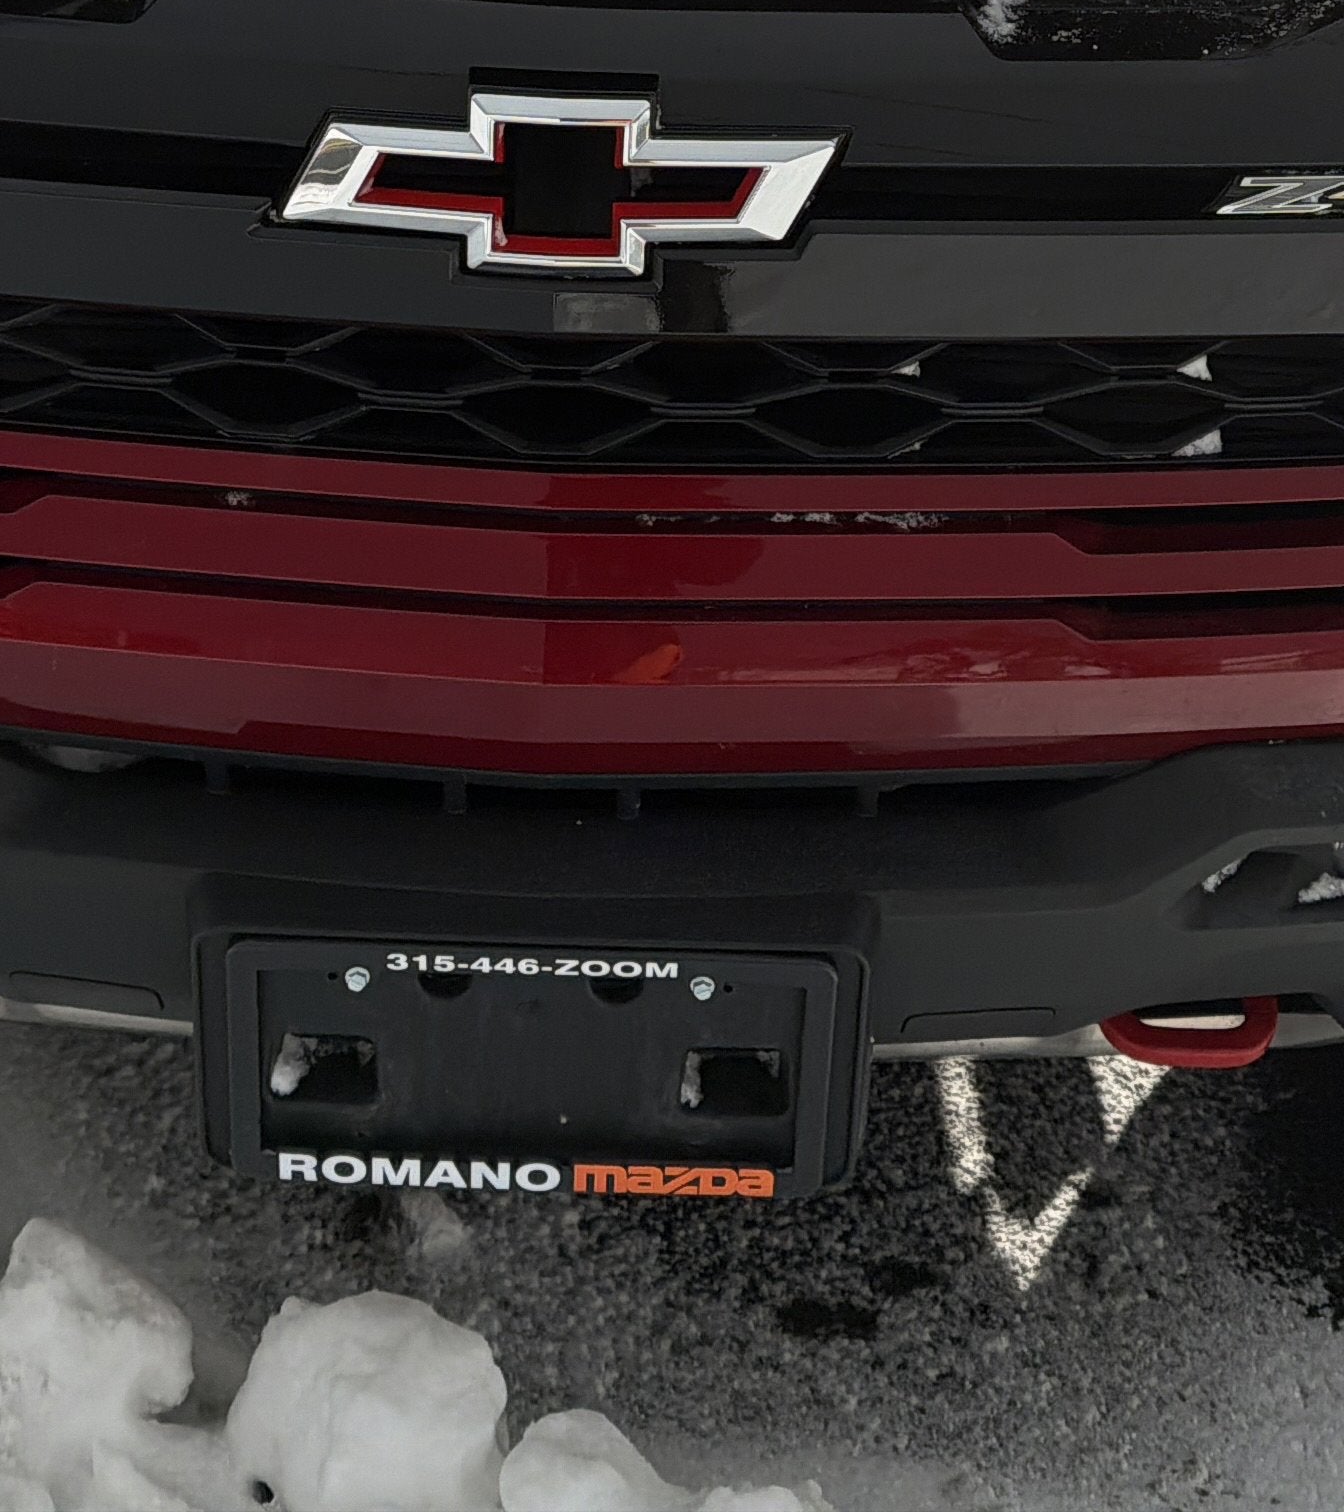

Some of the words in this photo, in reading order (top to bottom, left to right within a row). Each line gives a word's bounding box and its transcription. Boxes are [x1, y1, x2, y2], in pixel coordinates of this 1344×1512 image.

[386, 953, 679, 979] 315-446-ZOOM
[277, 1152, 561, 1192] ROMANO
[573, 1163, 774, 1198] mazda
